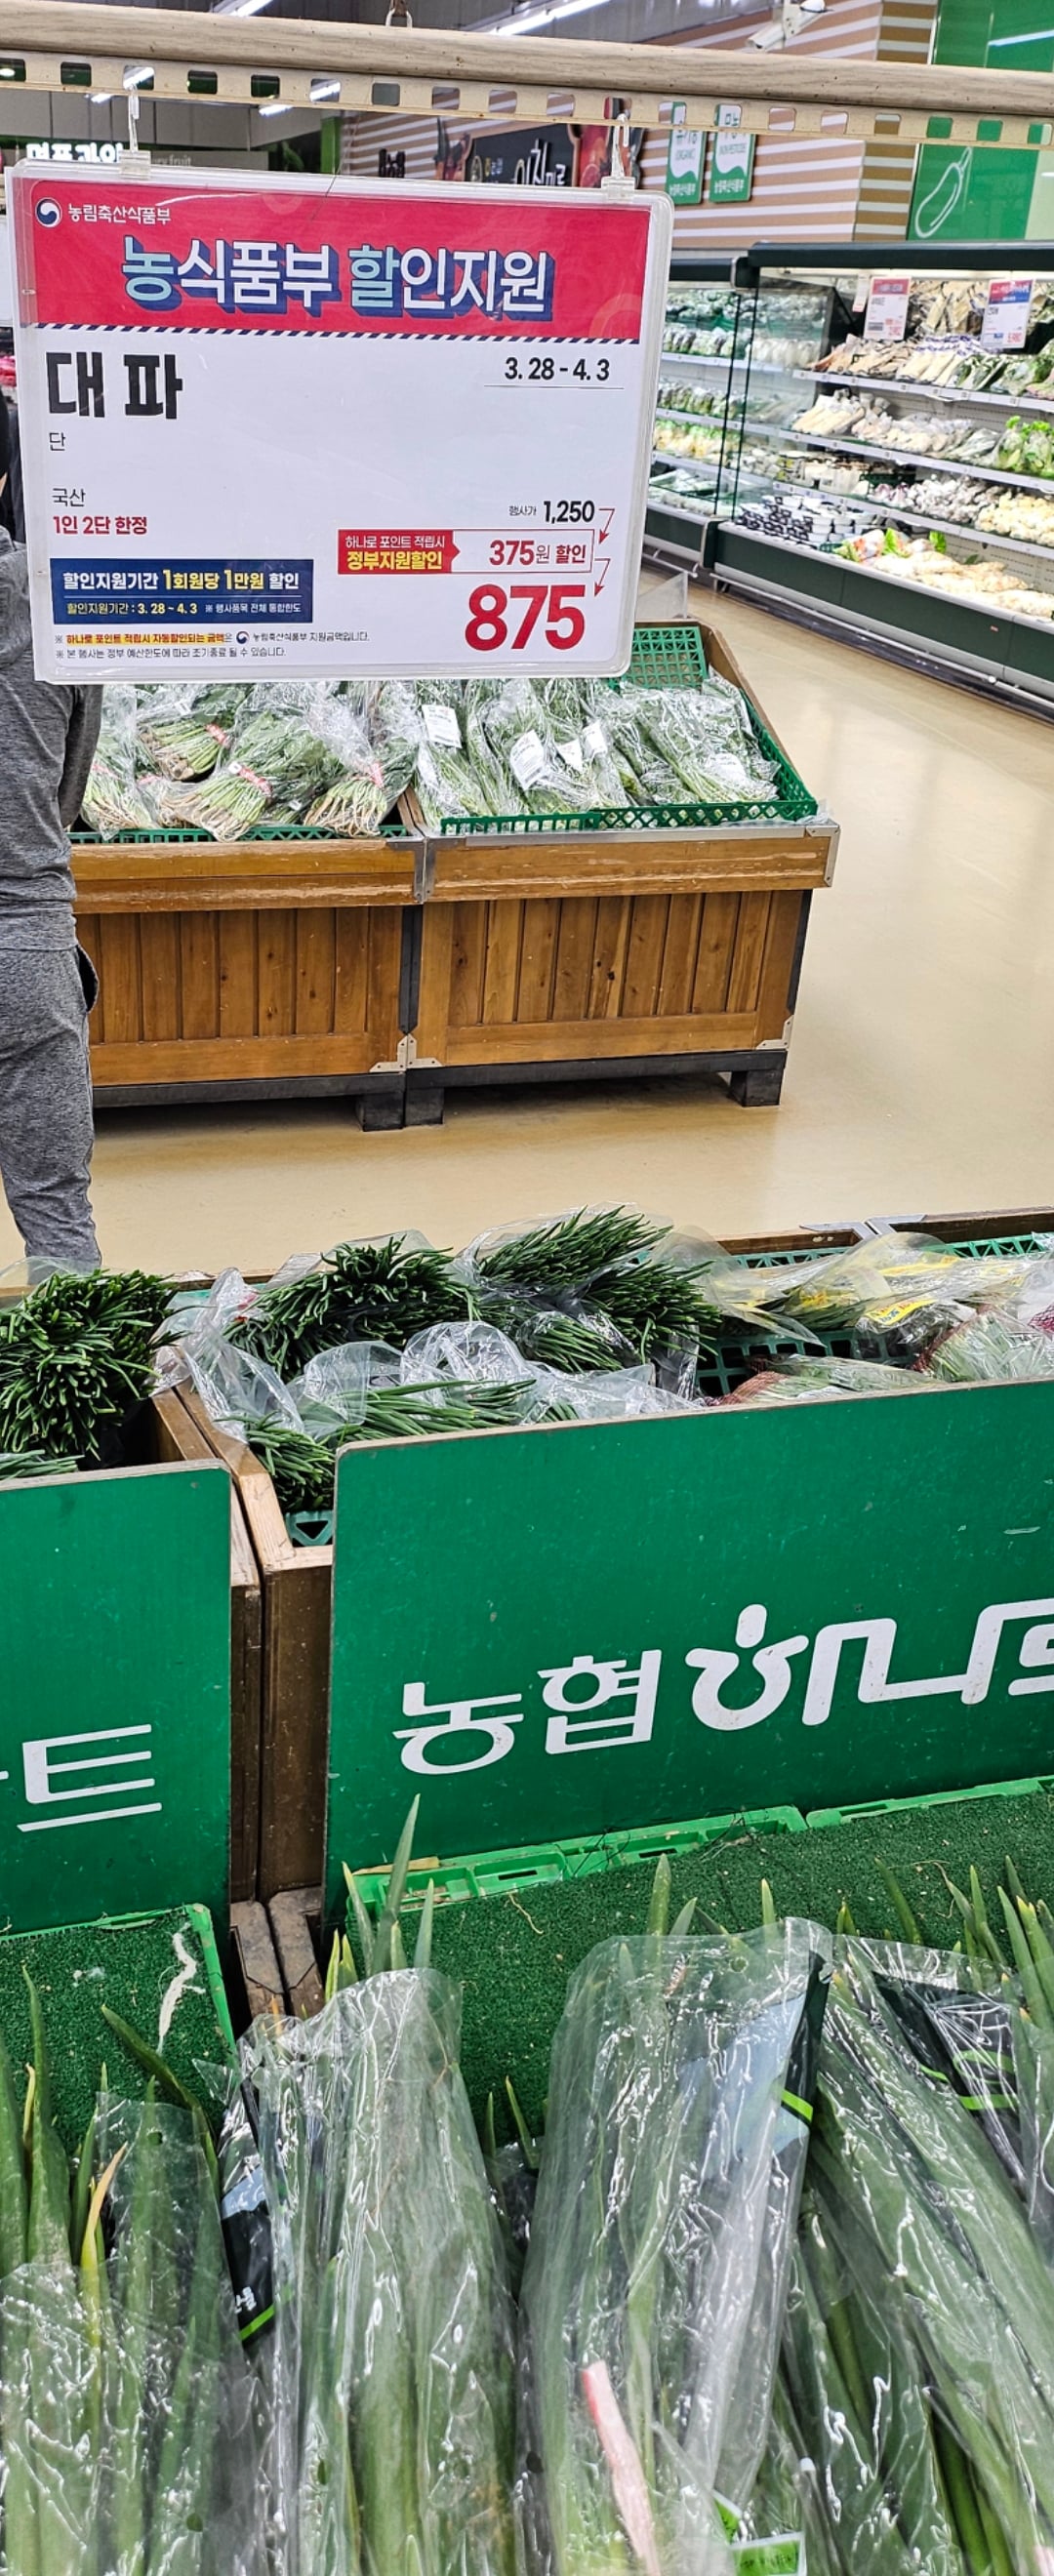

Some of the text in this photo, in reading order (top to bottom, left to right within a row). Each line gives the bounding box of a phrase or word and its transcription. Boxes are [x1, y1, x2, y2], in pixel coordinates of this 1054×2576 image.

[67, 203, 171, 225] 농림축산식품부
[122, 236, 547, 313] 농식품부 할인지원
[46, 351, 183, 420] 대 파
[49, 432, 66, 452] 단
[52, 488, 86, 507] 국산
[508, 500, 595, 524] 행사가 1,250
[53, 516, 148, 536] 1인 2단 한정
[345, 535, 445, 548] 하나로 포인트 적립시
[347, 550, 442, 571] 정부지원할인
[489, 540, 587, 566] 375원 할인
[62, 569, 300, 590] 할인지원기간 1회원당 1만원 할인
[66, 602, 129, 615] 할인지원기간
[465, 584, 586, 651] 875
[392, 1649, 663, 1775] 농협
[0, 1723, 163, 1832] 트
